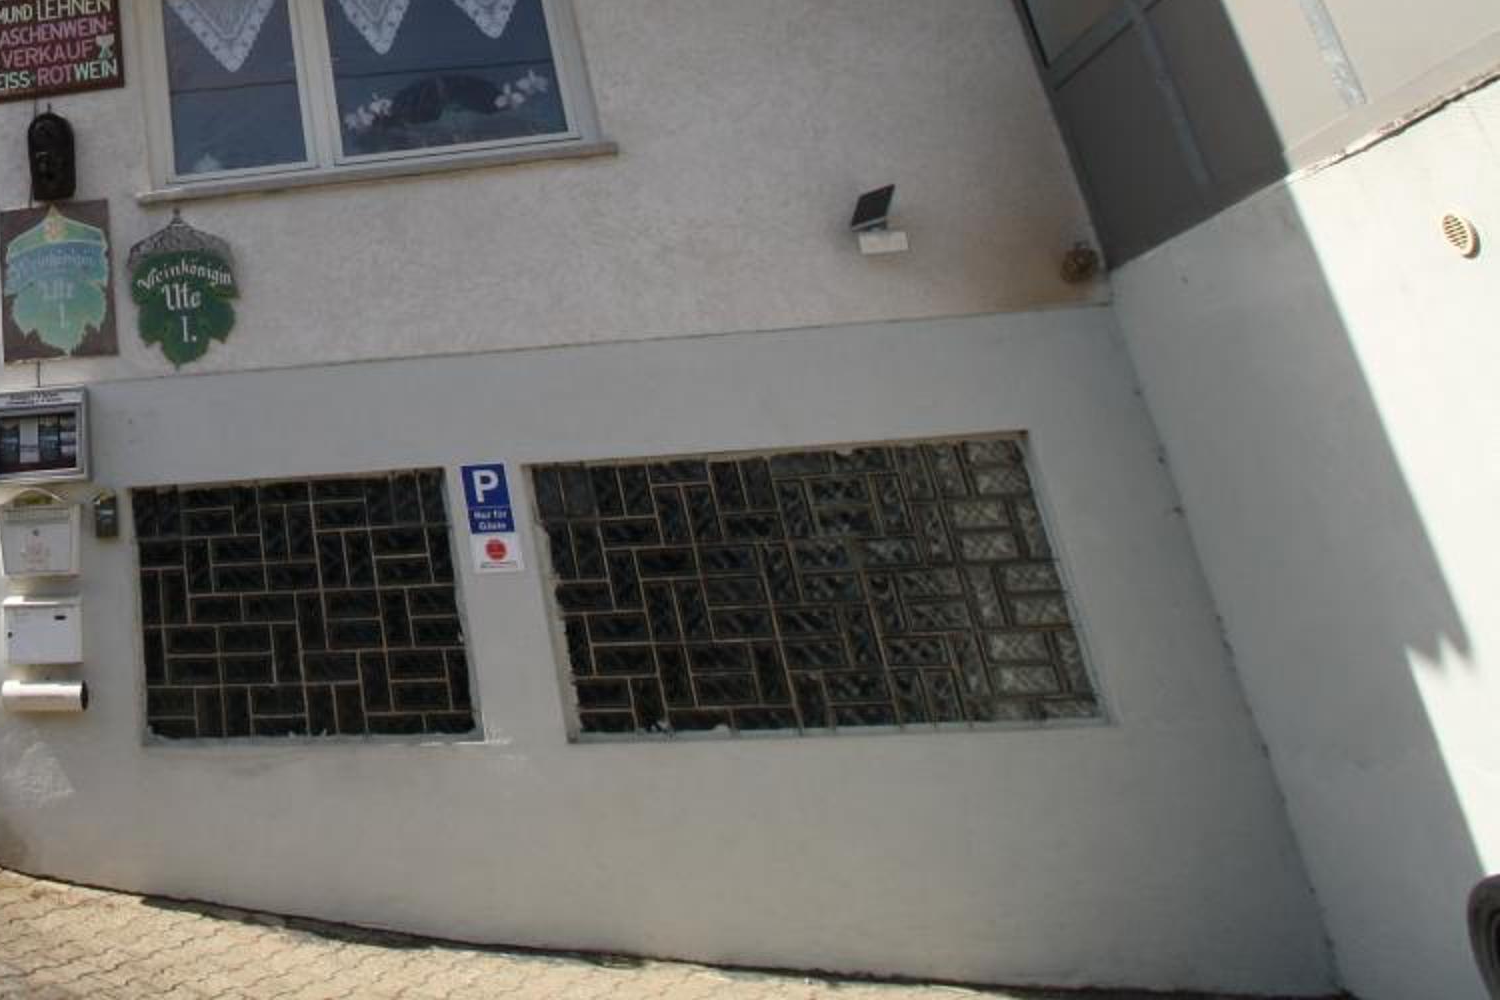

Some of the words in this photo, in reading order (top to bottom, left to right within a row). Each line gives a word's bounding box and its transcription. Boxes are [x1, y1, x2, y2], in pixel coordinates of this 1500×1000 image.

[1, 39, 94, 69] VERKAUF
[37, 59, 118, 87] ROTWEIN
[137, 258, 232, 291] Weinkönigin
[161, 282, 201, 310] Ute
[472, 469, 499, 503] P
